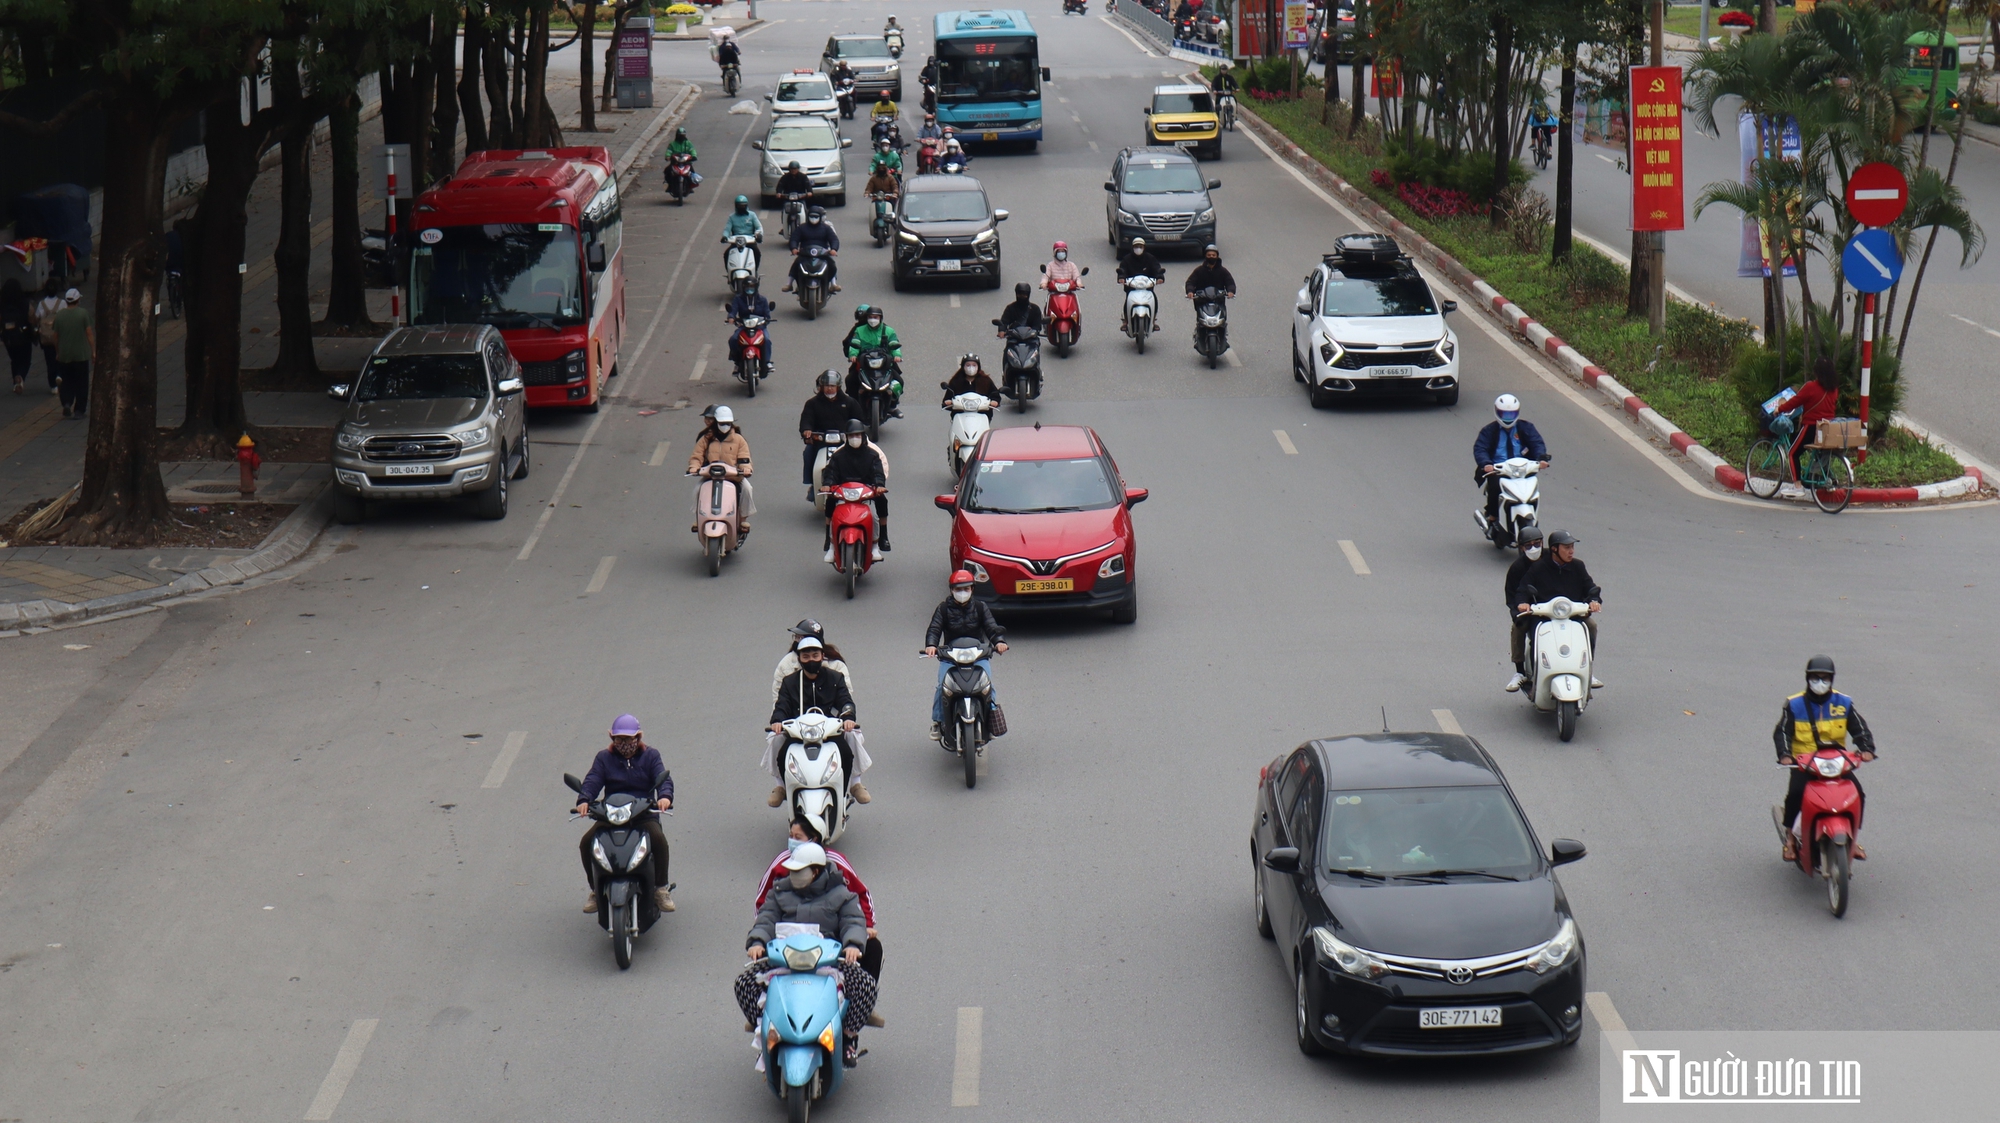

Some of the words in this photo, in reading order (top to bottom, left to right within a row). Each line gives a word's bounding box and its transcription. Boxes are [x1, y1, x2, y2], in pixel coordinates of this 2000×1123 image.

[1637, 101, 1651, 118] NƯỚC
[1652, 101, 1666, 120] CỘNG
[1635, 125, 1642, 141] XÃ
[1643, 125, 1652, 143] HỘI
[1653, 123, 1663, 141] CHỦ
[1664, 126, 1680, 141] NGHĨA
[1646, 148, 1657, 166] VIỆT
[1658, 150, 1670, 164] NAM
[1643, 171, 1658, 187] MUÔN
[1659, 170, 1673, 187] NĂM!
[1373, 368, 1409, 376] 30K-666.57
[389, 466, 431, 474] 30L-047.35
[1020, 581, 1068, 591] 29E-398.01
[1829, 702, 1847, 717] be
[1422, 1009, 1500, 1026] 30E-771.42
